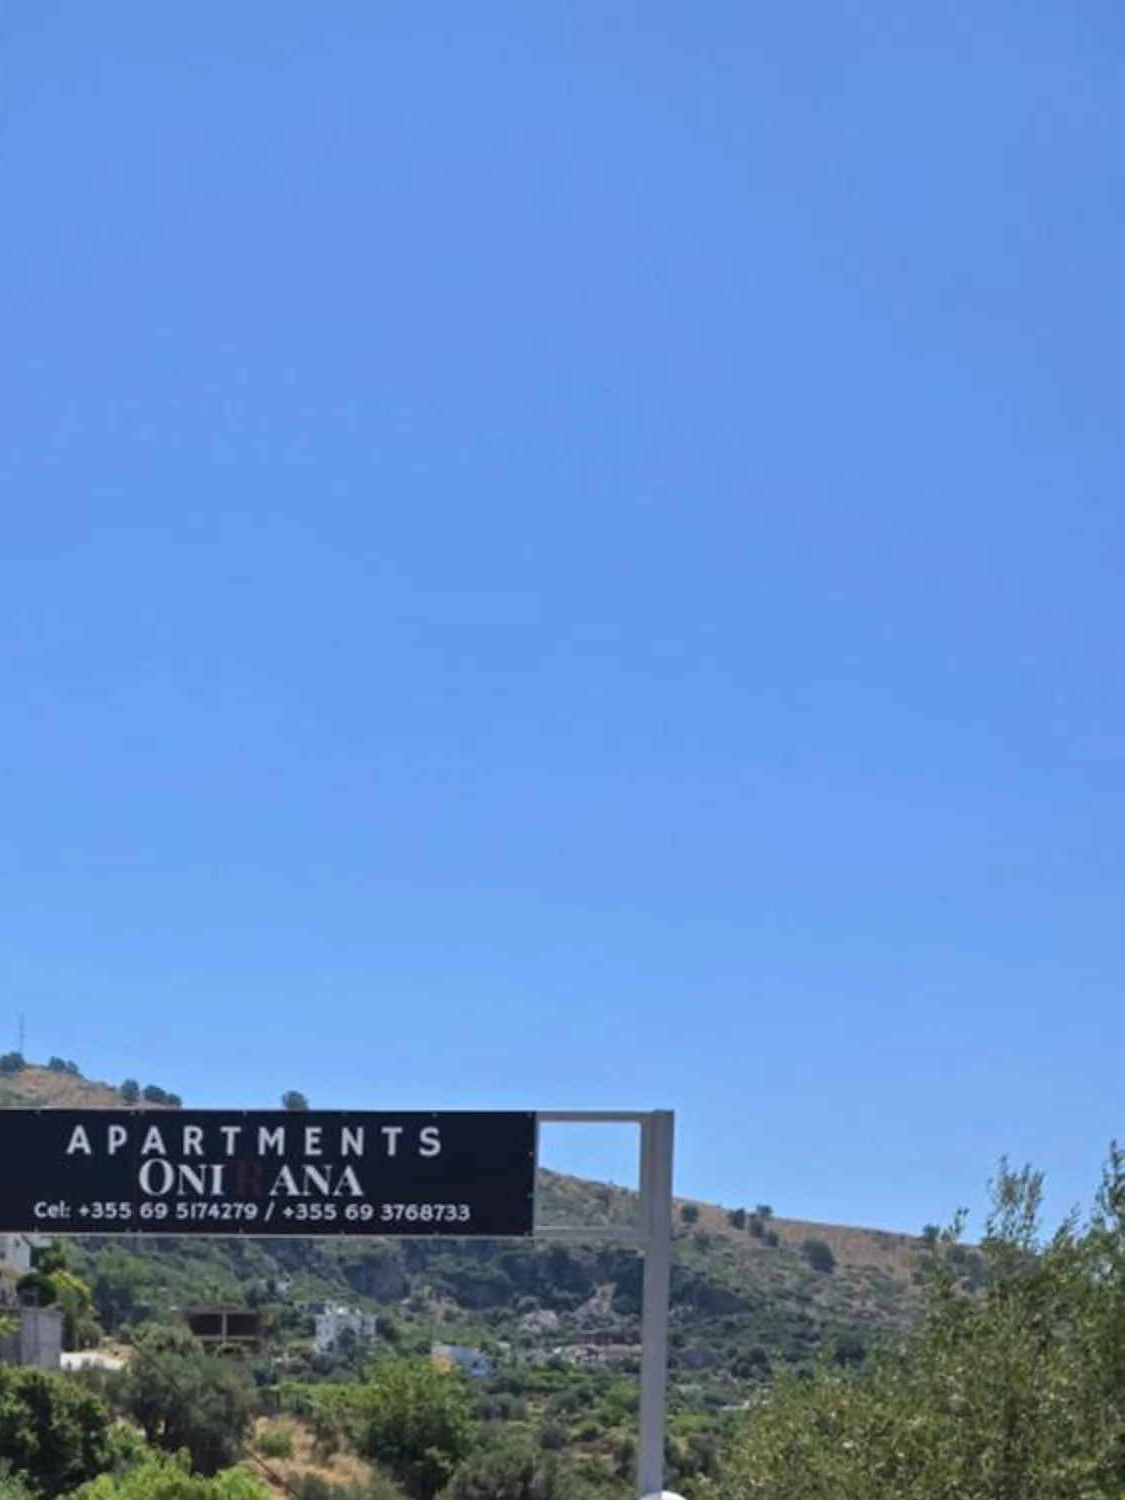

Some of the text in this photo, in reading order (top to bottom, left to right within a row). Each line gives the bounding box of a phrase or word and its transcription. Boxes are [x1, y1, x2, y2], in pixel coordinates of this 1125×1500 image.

[66, 1125, 442, 1157] APARTMENTS
[33, 1201, 471, 1223] Cel: +355 69 5174279 / +355 69 3768733
